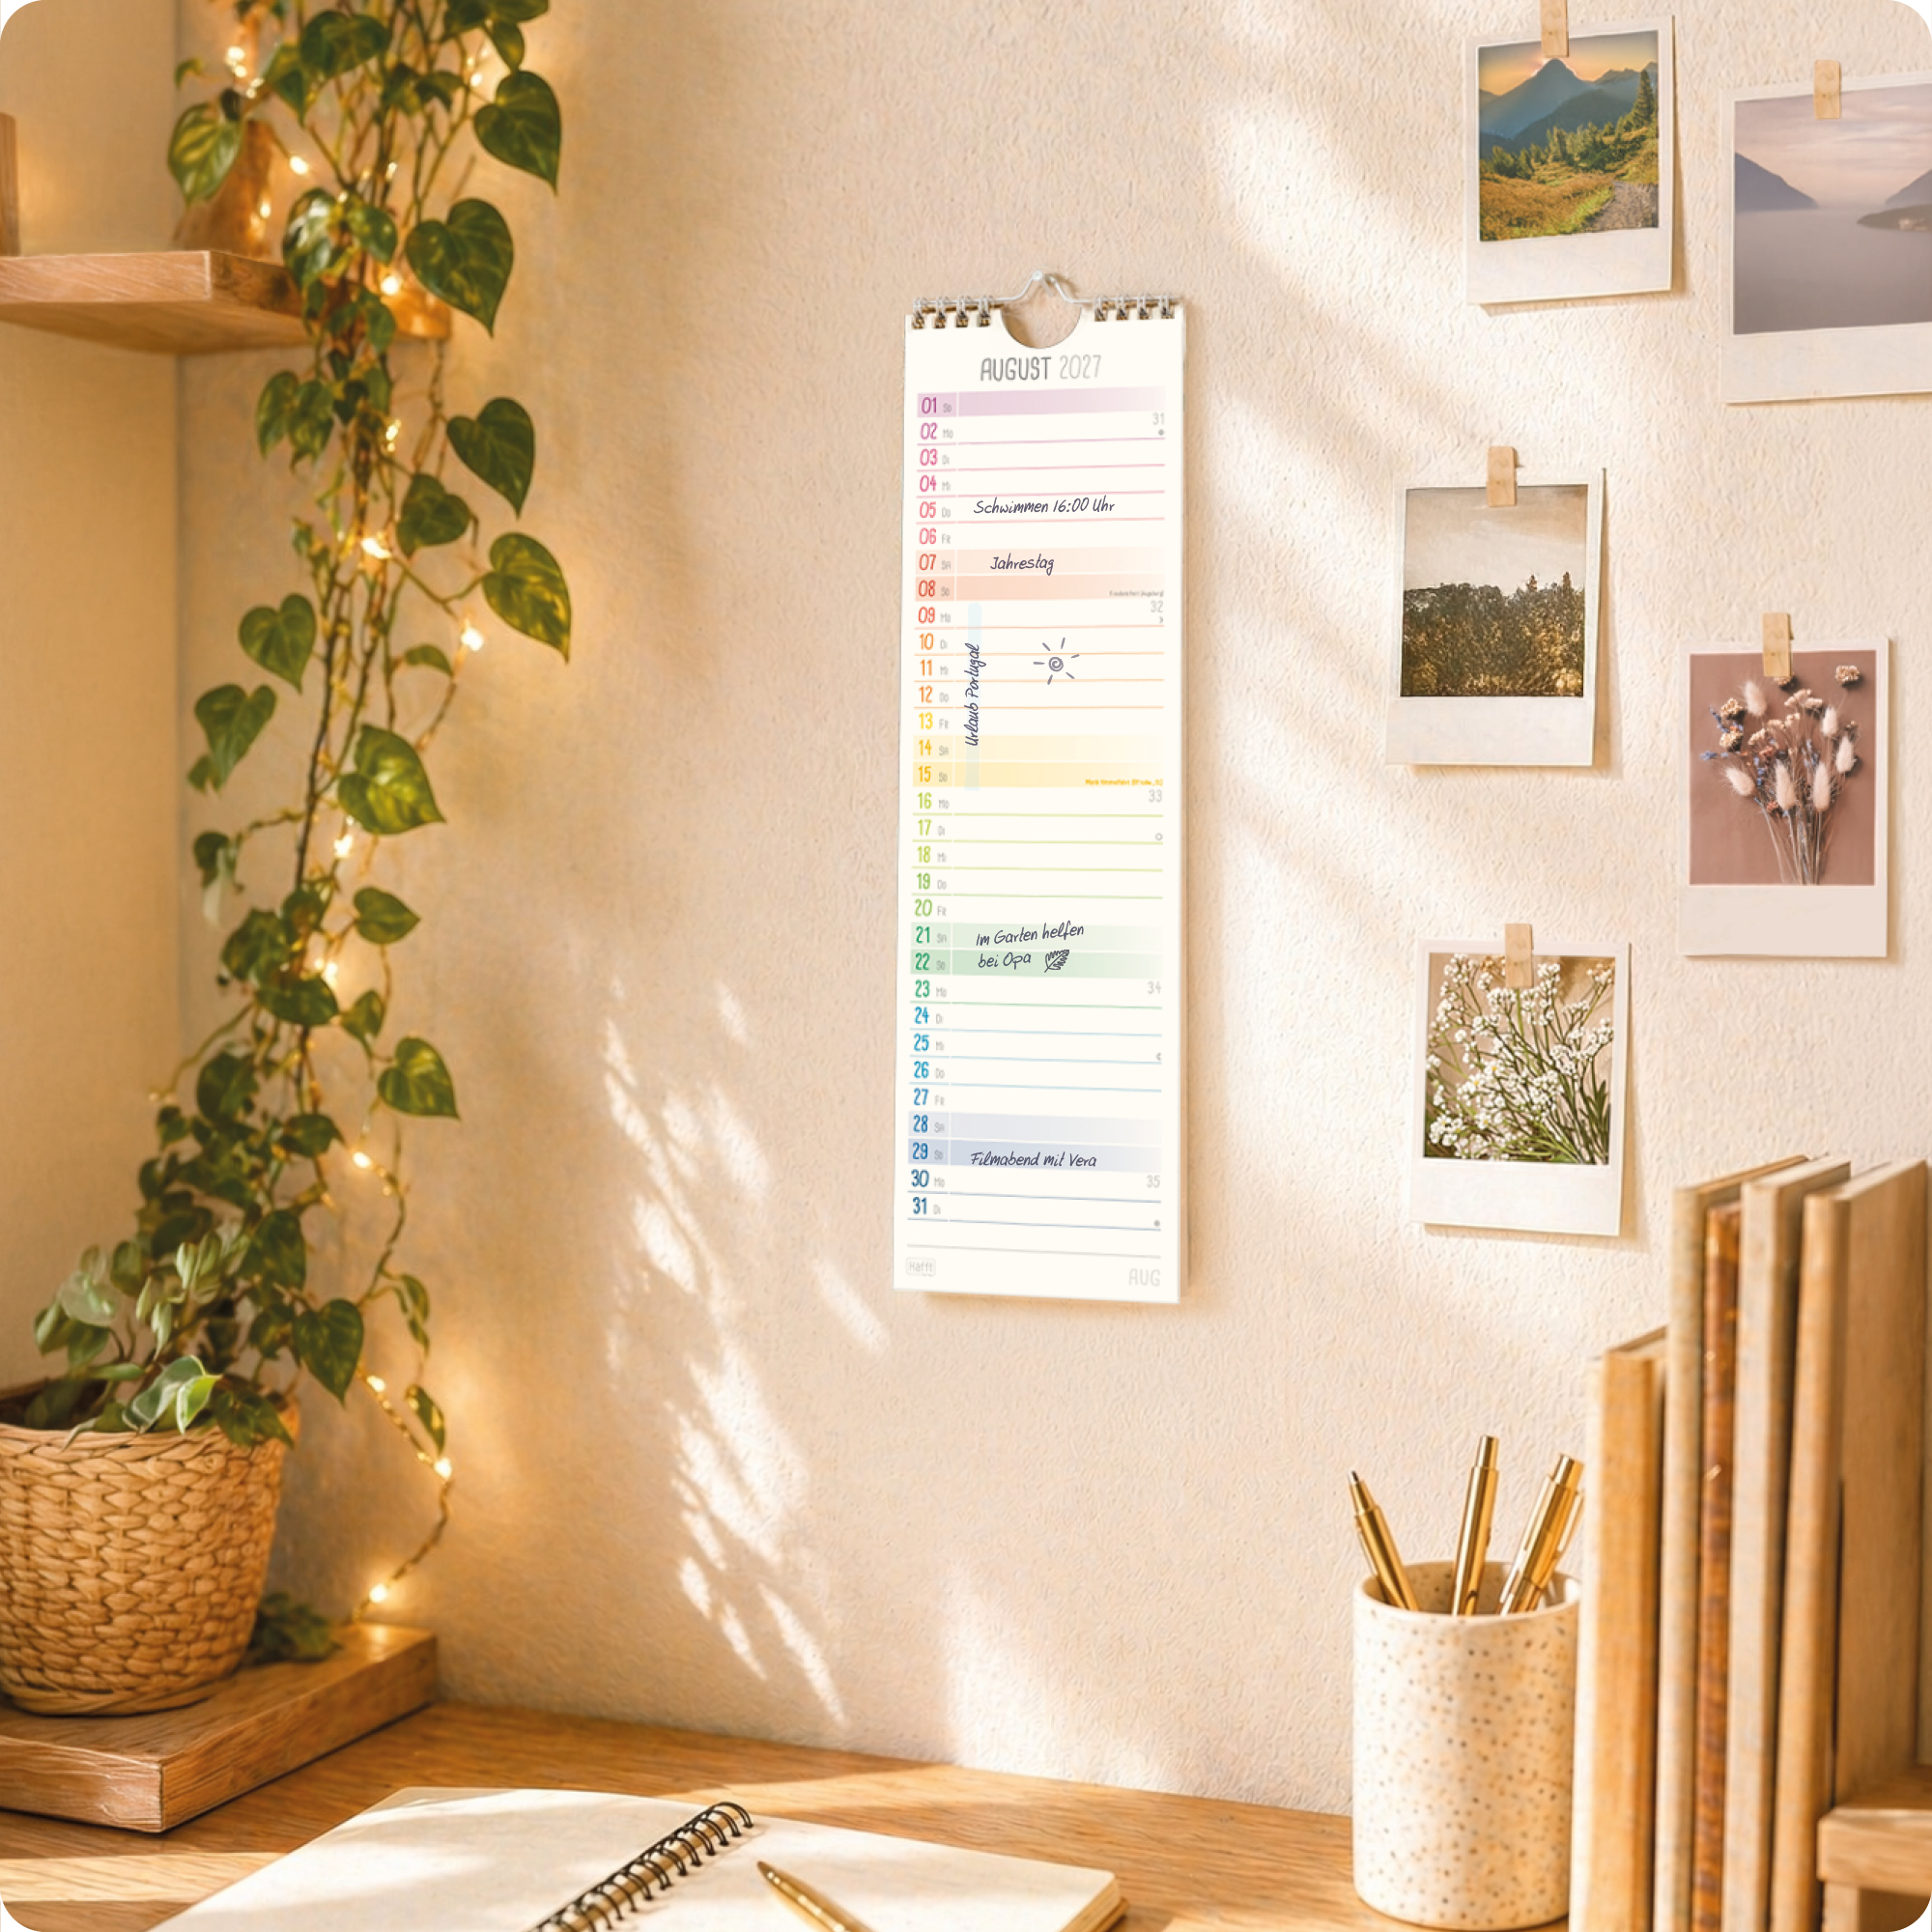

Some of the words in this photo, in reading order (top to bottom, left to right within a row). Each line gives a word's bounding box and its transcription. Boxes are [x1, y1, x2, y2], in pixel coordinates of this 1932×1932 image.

[980, 356, 1051, 382] AUGUST
[1060, 354, 1101, 380] 2027
[922, 397, 936, 413] 01
[1152, 412, 1165, 425] 31
[921, 422, 938, 440] 02
[920, 448, 938, 466] 03
[920, 475, 936, 492] 04
[920, 501, 936, 518] 05
[973, 497, 1049, 513] Schwimmen
[1053, 497, 1089, 512] 16:00
[1093, 495, 1116, 512] Uhr
[920, 527, 936, 544] 06
[919, 554, 936, 570] 07
[990, 553, 1054, 576] Jahrestag
[919, 581, 935, 597] 08
[1151, 600, 1163, 612] 32
[919, 607, 935, 624] 09
[920, 633, 933, 650] 10
[921, 660, 932, 676] 11
[963, 643, 986, 697] Portugal
[919, 686, 932, 702] 12
[919, 712, 933, 729] 13
[963, 702, 980, 746] Urlaub
[919, 739, 932, 755] 14
[919, 766, 931, 782] 15
[918, 792, 931, 809] 16
[1149, 789, 1162, 803] 33
[919, 819, 931, 836] 17
[918, 846, 930, 863] 18
[917, 872, 930, 890] 19
[915, 899, 932, 917] 20
[916, 926, 929, 944] 21
[994, 927, 1037, 944] Garten
[1042, 921, 1084, 940] helfen
[916, 952, 930, 970] 22
[978, 953, 999, 968] bei
[1003, 952, 1031, 970] Opa
[916, 980, 929, 998] 23
[1148, 981, 1161, 995] 34
[915, 1007, 929, 1024] 24
[914, 1034, 929, 1051] 25
[914, 1061, 929, 1078] 26
[914, 1088, 928, 1105] 27
[914, 1115, 927, 1133] 28
[913, 1142, 927, 1159] 29
[971, 1151, 1039, 1167] Filmabend
[1043, 1151, 1065, 1167] mit
[1069, 1153, 1097, 1167] Vera
[911, 1169, 929, 1187] 30
[1147, 1175, 1160, 1188] 35
[913, 1197, 926, 1214] 31
[1129, 1268, 1160, 1287] AUG
